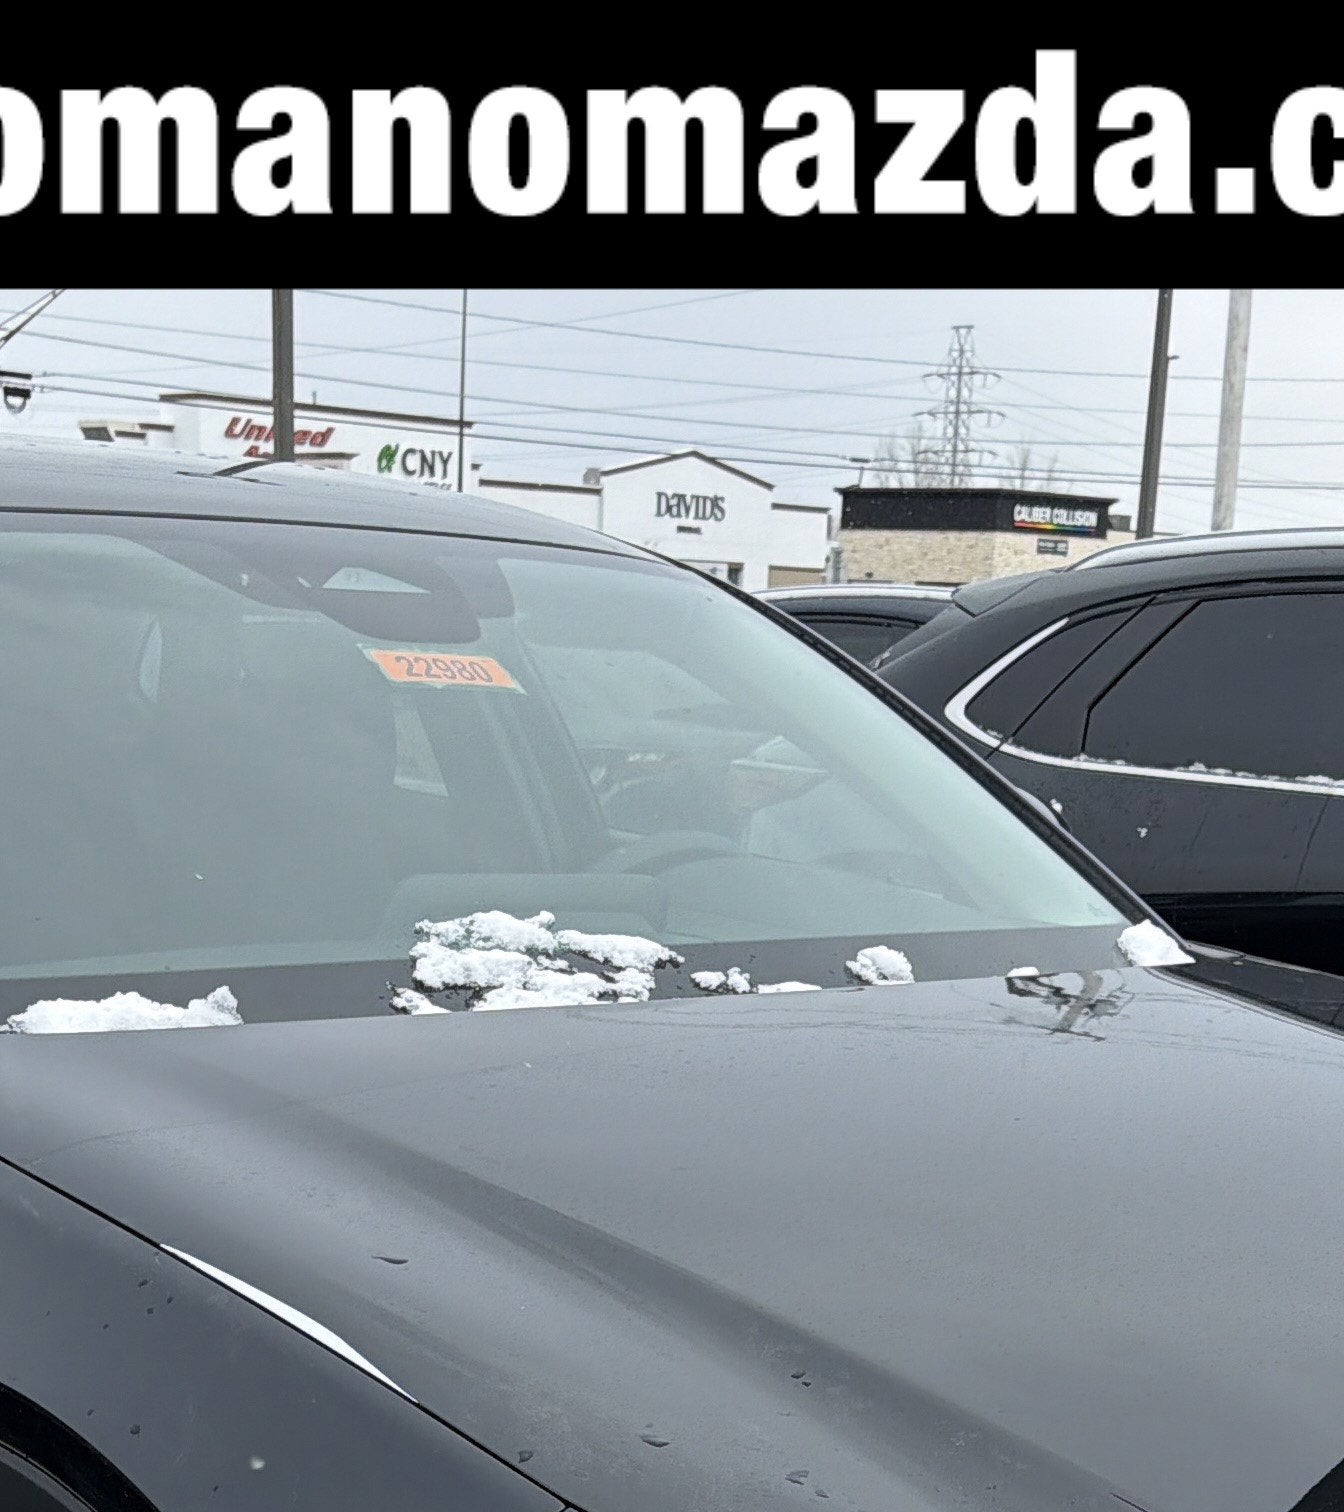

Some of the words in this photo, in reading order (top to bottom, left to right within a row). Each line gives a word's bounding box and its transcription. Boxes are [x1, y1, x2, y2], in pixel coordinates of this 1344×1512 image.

[224, 416, 336, 448] Unied
[401, 447, 454, 480] CNY
[394, 655, 494, 683] 22980
